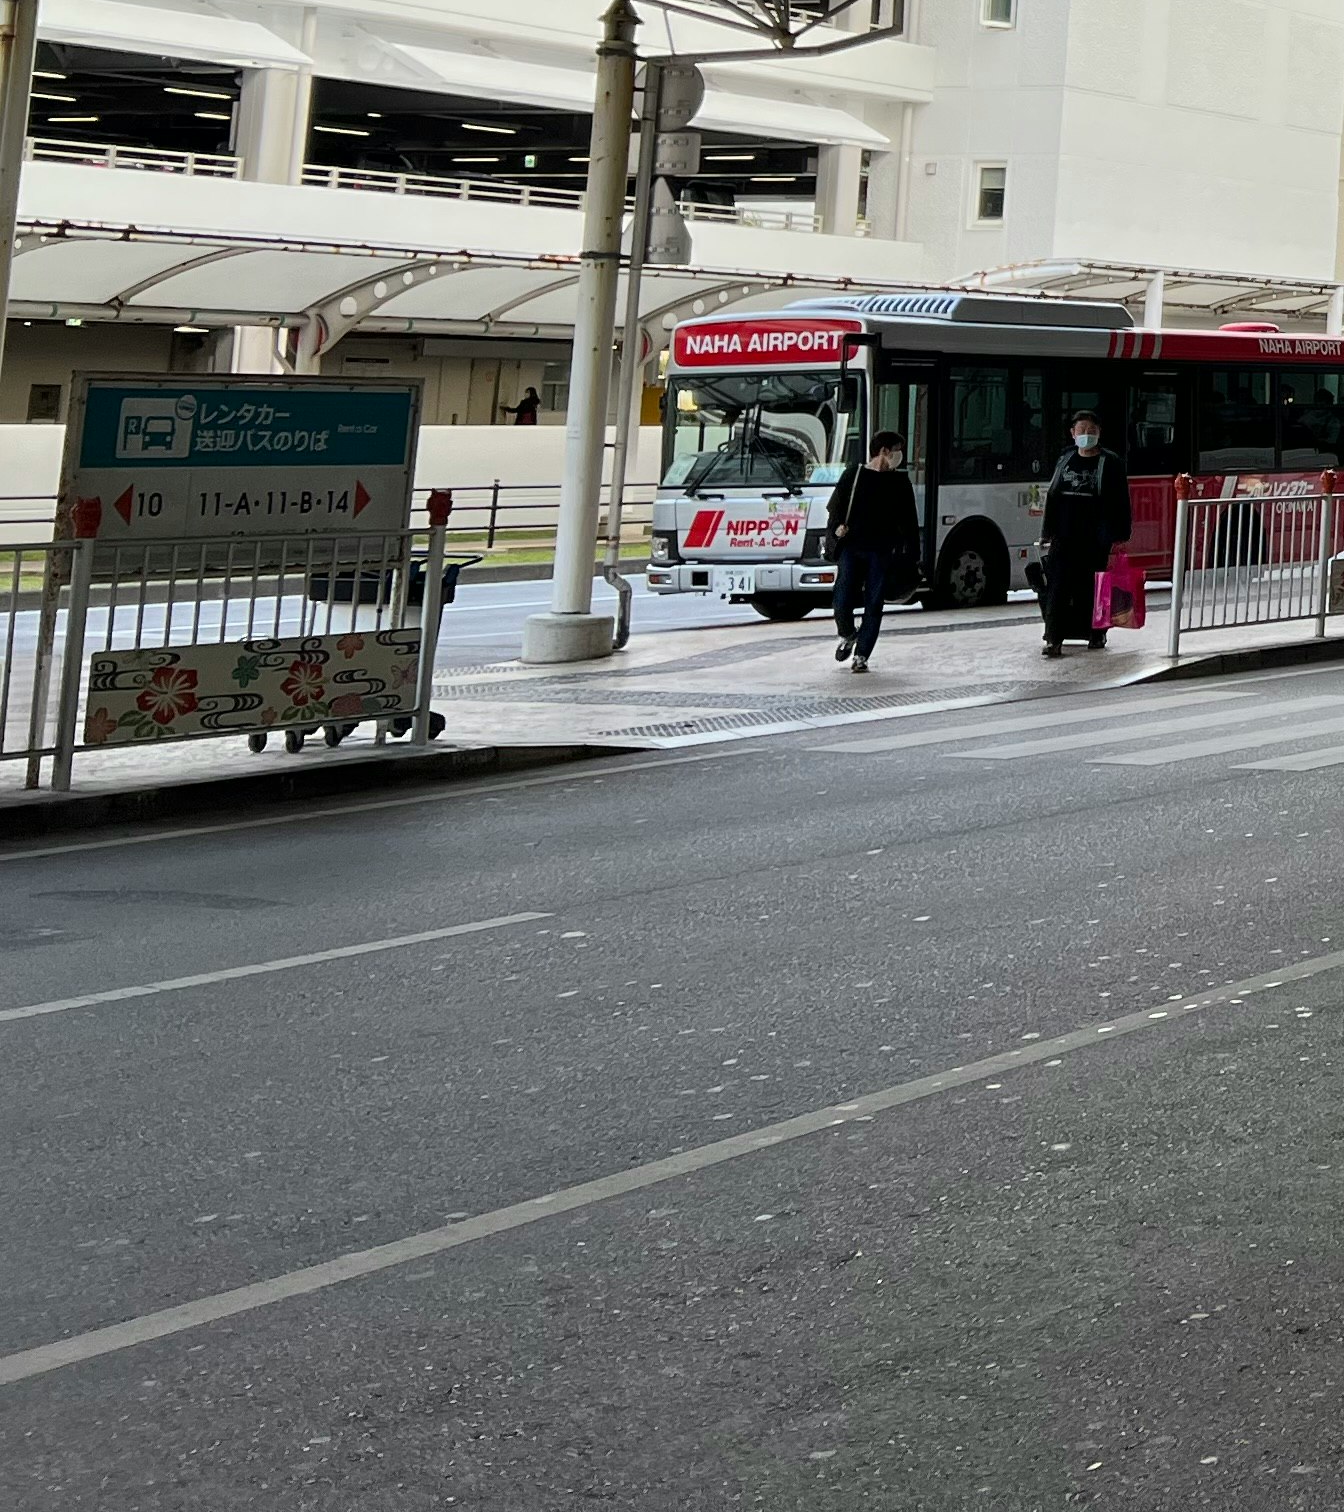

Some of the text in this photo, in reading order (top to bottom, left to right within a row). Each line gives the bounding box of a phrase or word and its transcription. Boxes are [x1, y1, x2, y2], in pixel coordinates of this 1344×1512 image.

[685, 330, 840, 355] NAHA AIRPORT
[1258, 338, 1342, 356] NAHA AIRPORT
[200, 402, 290, 425] レンタカー
[194, 430, 329, 451] 送迎バスのりば
[138, 492, 163, 517] 10
[726, 519, 799, 536] NIPPON
[729, 537, 790, 548] Rent-A-Car
